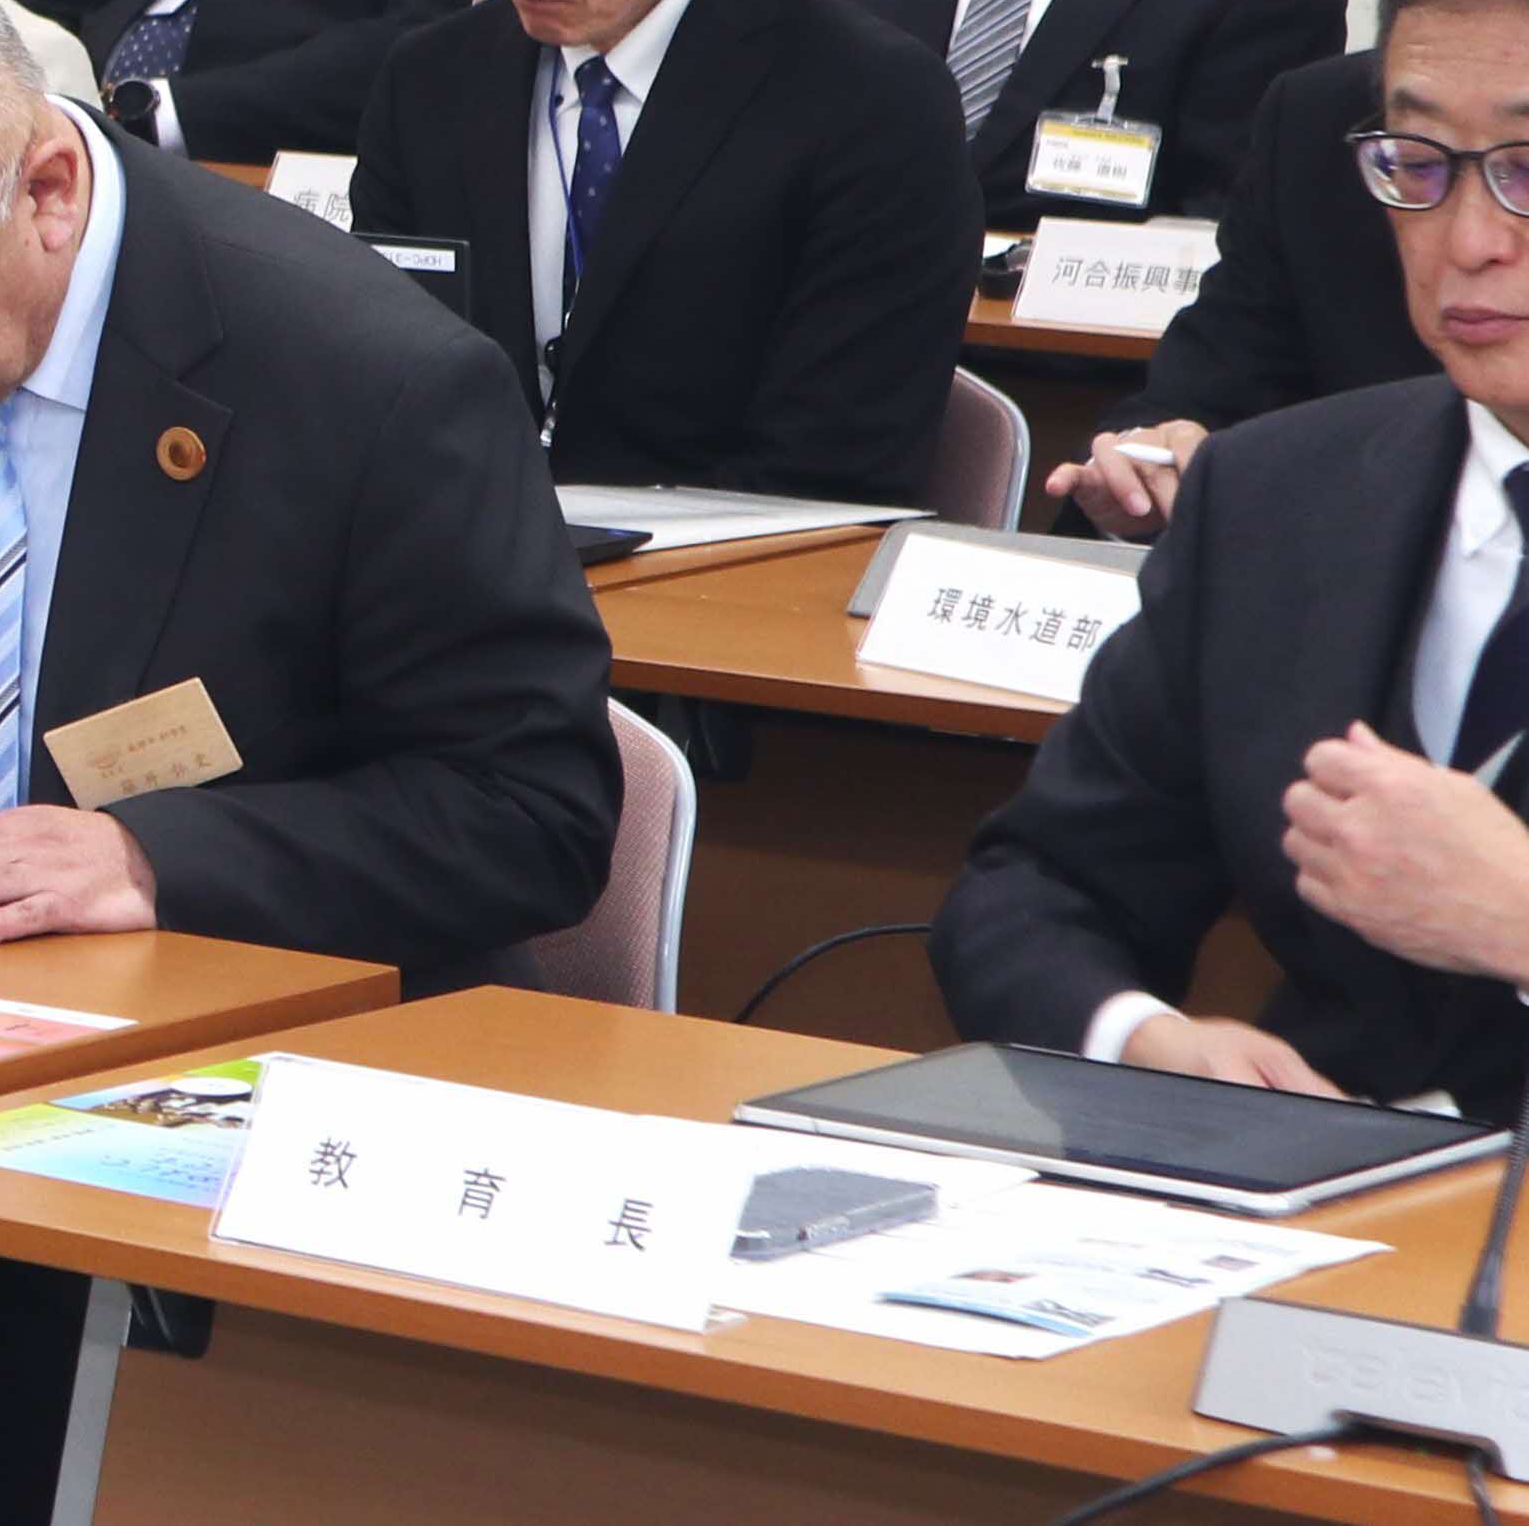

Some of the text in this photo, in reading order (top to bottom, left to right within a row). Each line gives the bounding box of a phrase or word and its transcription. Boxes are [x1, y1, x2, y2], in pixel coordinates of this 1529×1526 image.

[926, 586, 1104, 653] 環境水道部
[308, 1136, 654, 1252] 教育長
